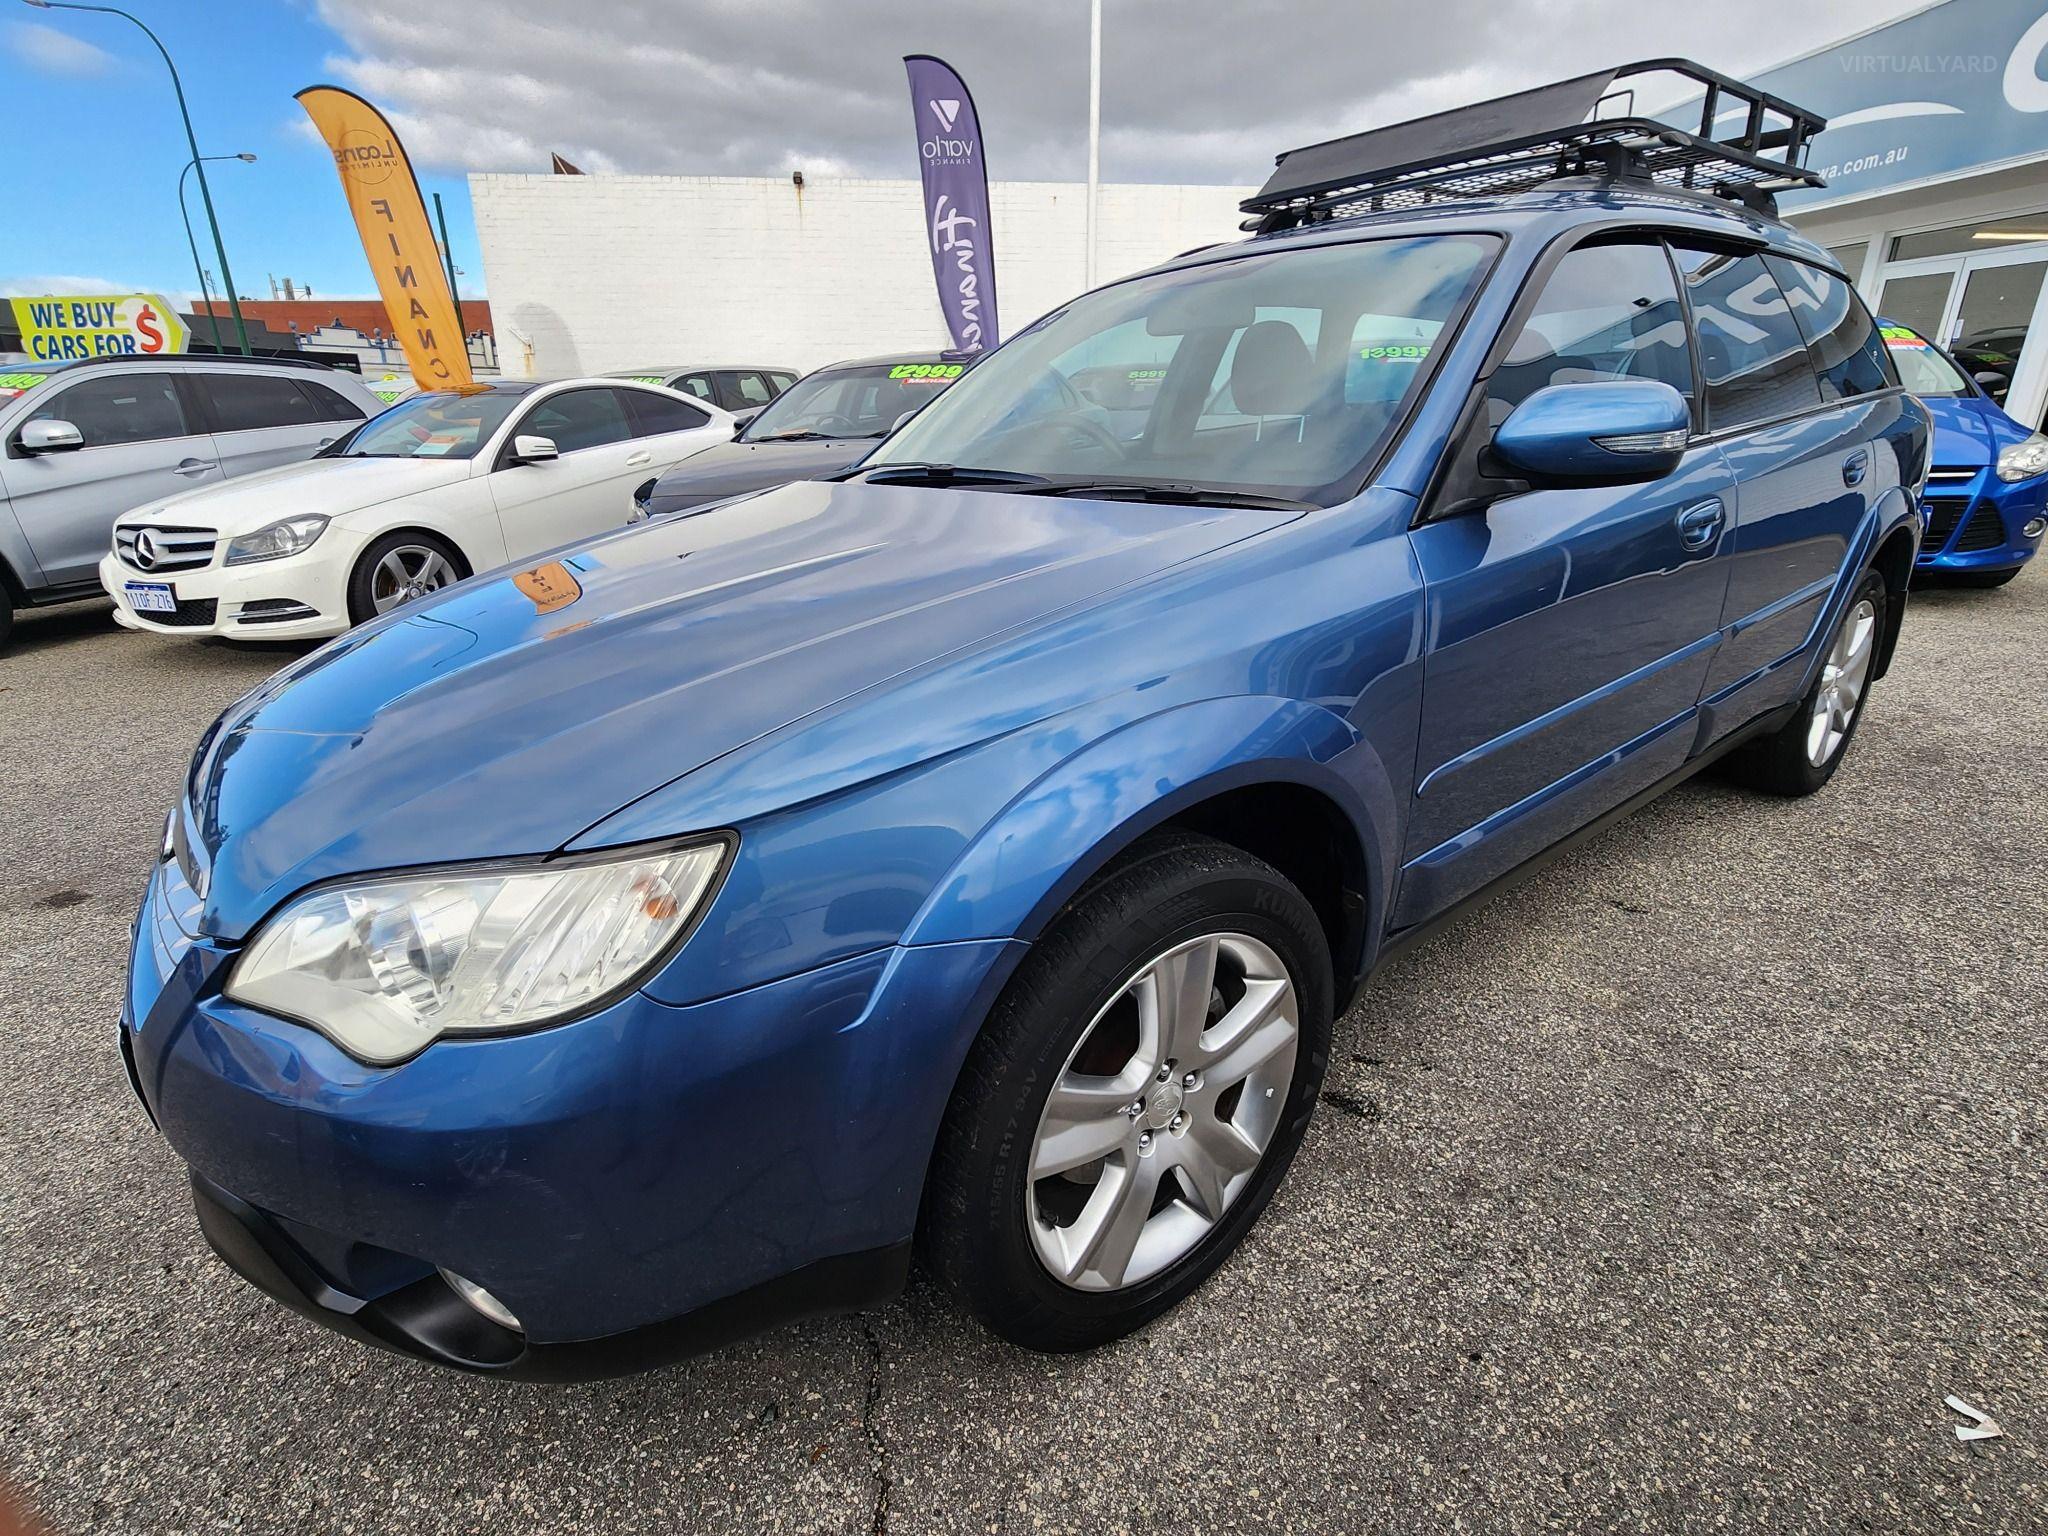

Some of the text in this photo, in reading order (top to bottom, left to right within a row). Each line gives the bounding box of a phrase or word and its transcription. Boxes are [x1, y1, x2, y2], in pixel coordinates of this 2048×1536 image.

[29, 302, 116, 329] WE BUY
[32, 334, 88, 361] CARS
[94, 334, 136, 356] FOR
[888, 364, 963, 378] 12999
